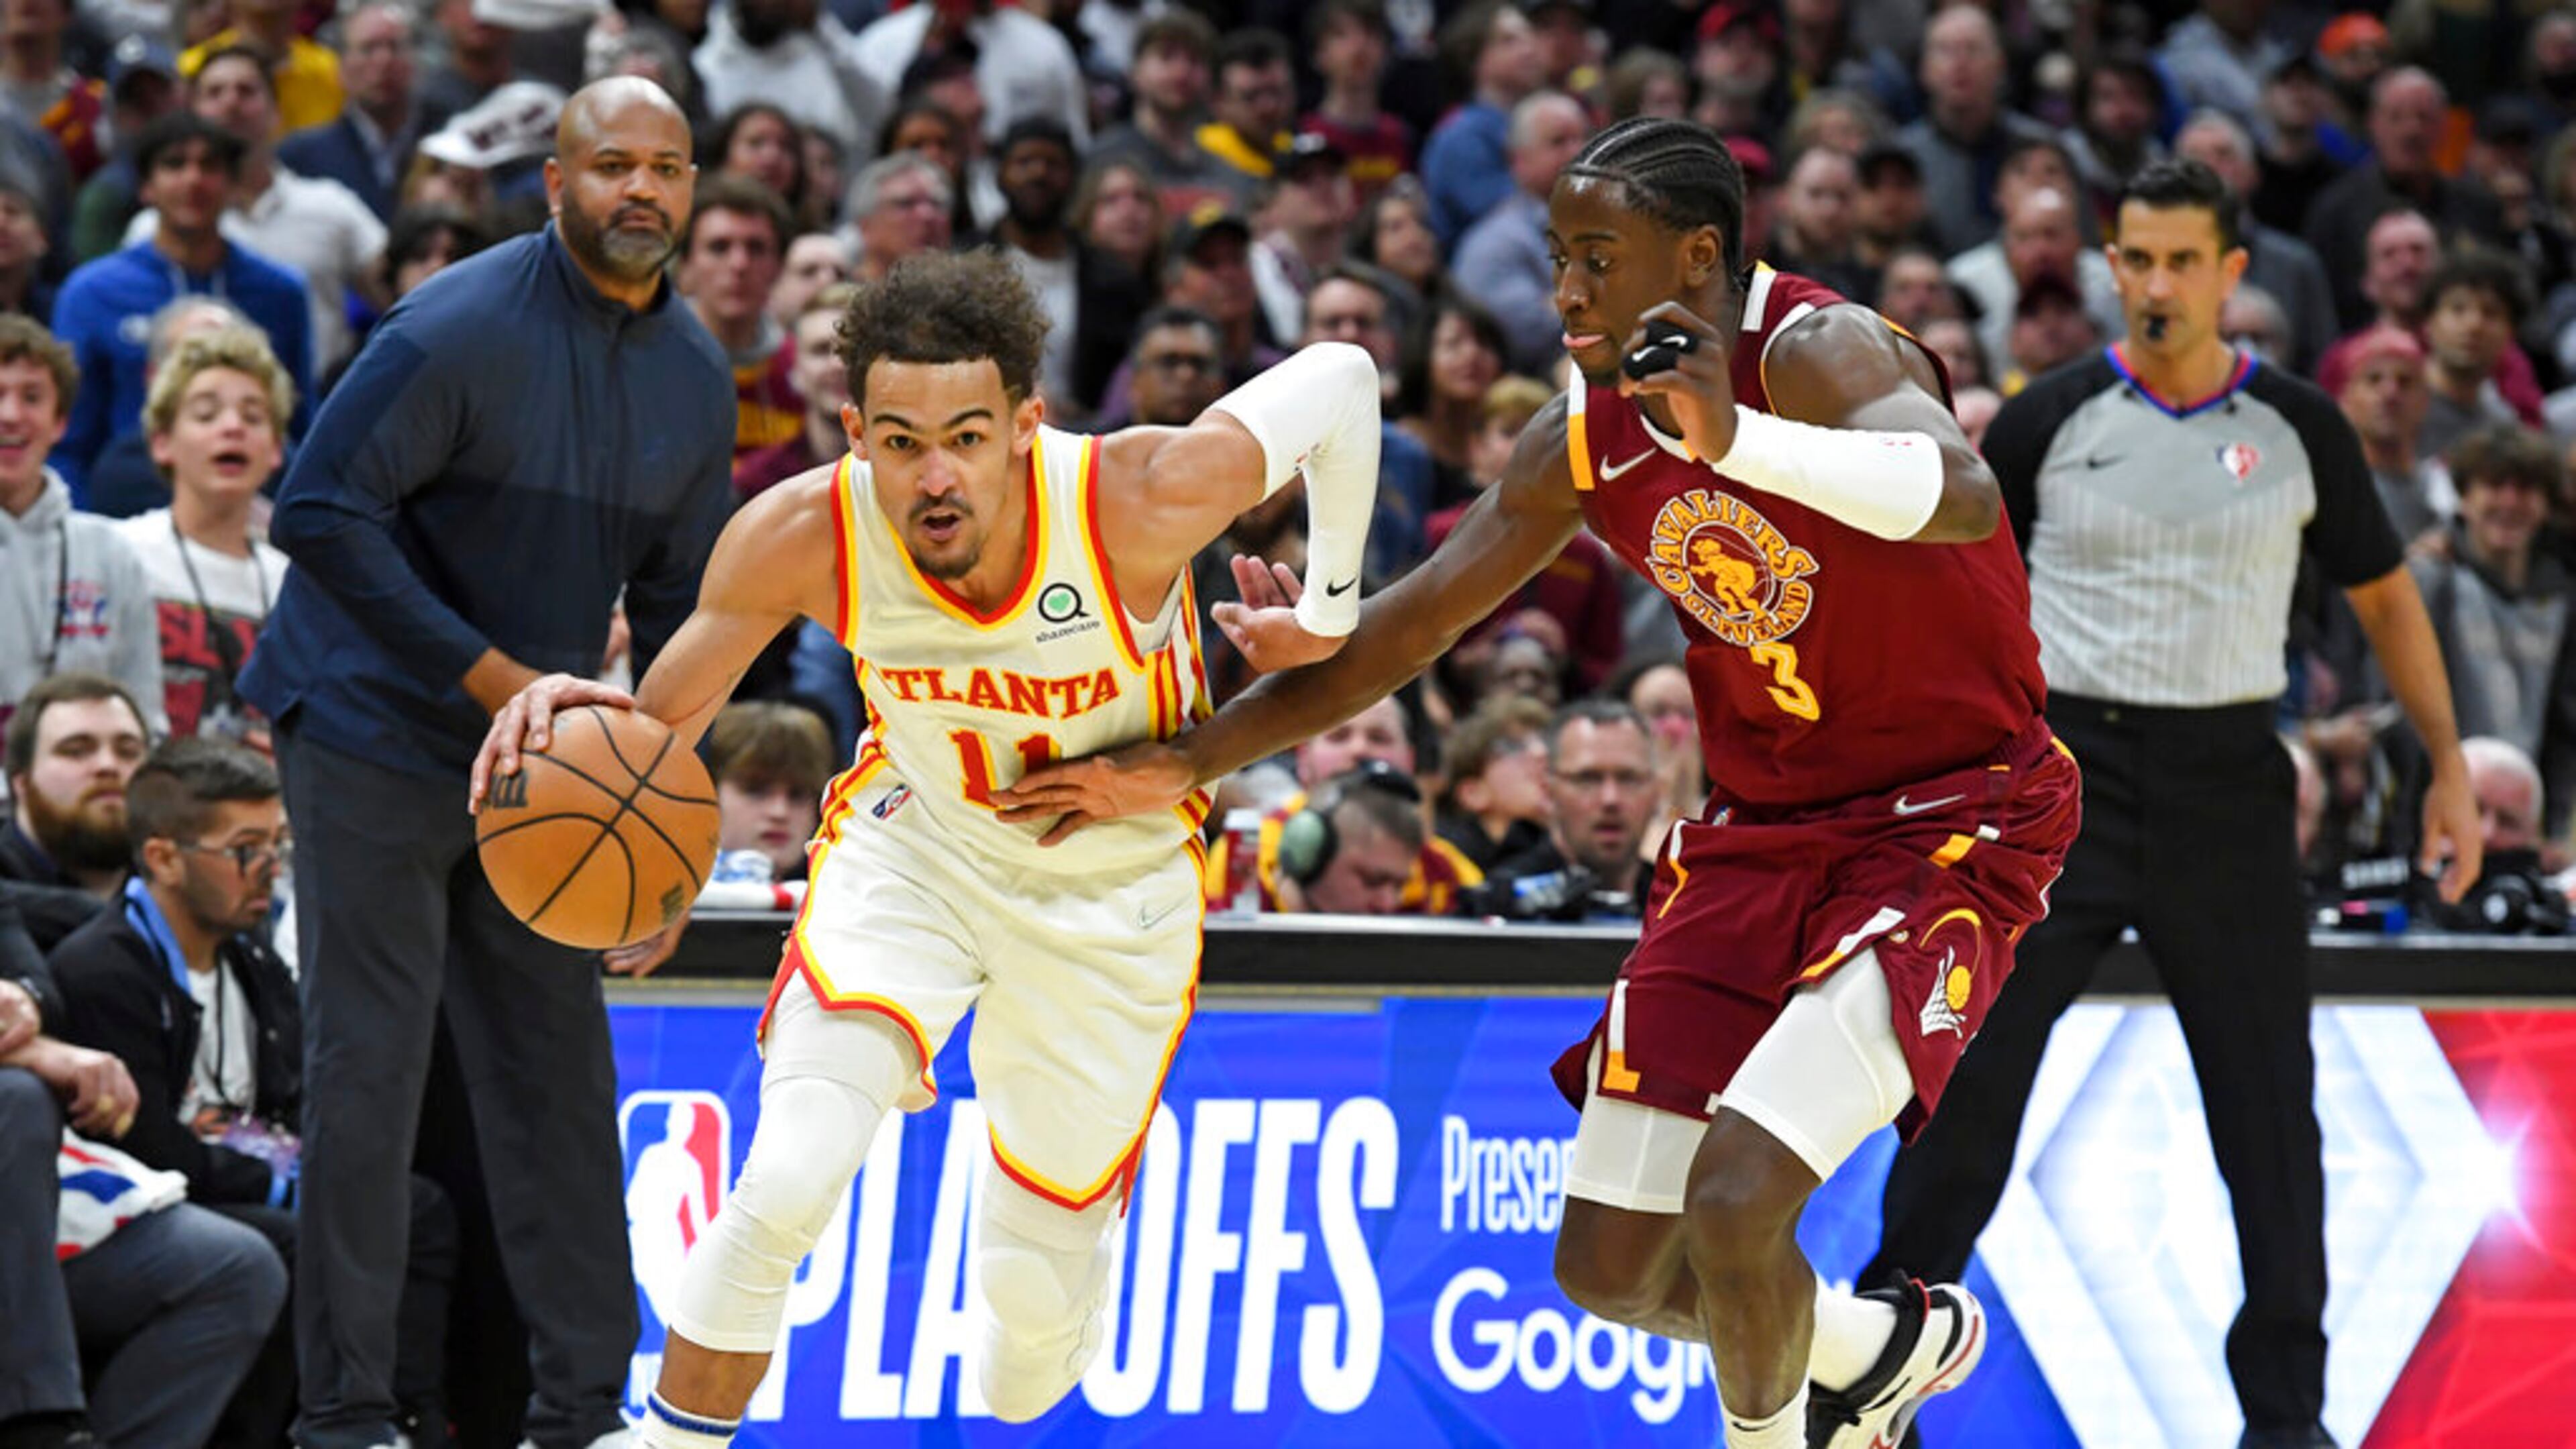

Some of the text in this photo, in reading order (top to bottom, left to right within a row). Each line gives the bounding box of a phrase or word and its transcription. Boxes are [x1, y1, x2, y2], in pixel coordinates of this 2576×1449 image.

[1645, 489, 1820, 597] CAVALIERS
[1680, 580, 1813, 647] CLEVELAND
[880, 666, 1121, 720] TLANTA
[1750, 641, 1821, 721] 3
[747, 1096, 1399, 1421] PLAOFFS
[1432, 1267, 1717, 1424] Goog
